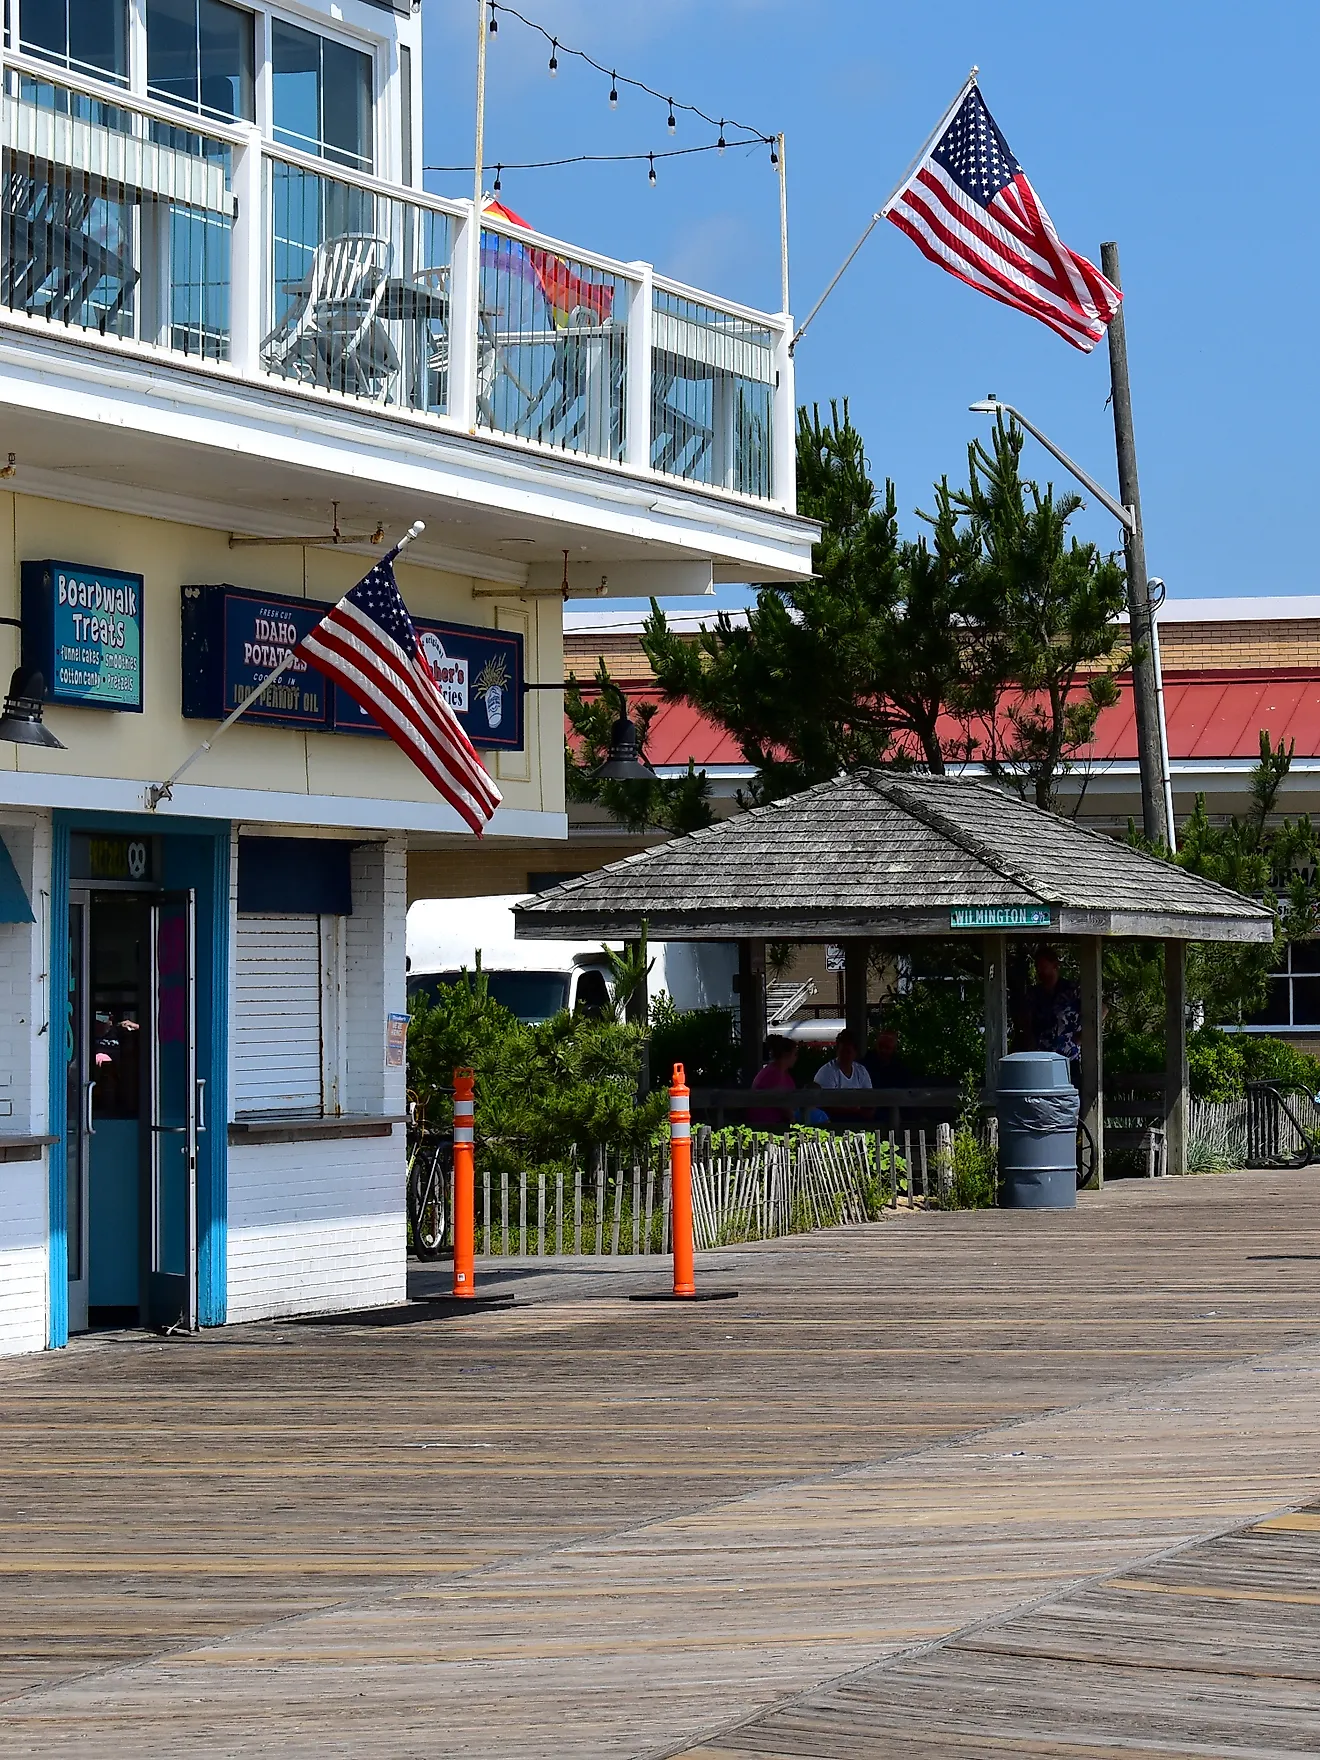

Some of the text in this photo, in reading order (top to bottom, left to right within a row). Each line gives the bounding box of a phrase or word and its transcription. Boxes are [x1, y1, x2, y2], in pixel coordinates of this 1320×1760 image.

[260, 608, 292, 620] FRESH CUT
[72, 613, 127, 648] Treats
[255, 618, 297, 645] IDAHO
[287, 678, 296, 686] IN
[303, 692, 319, 713] OIL
[955, 908, 1027, 925] WILMINGTON
